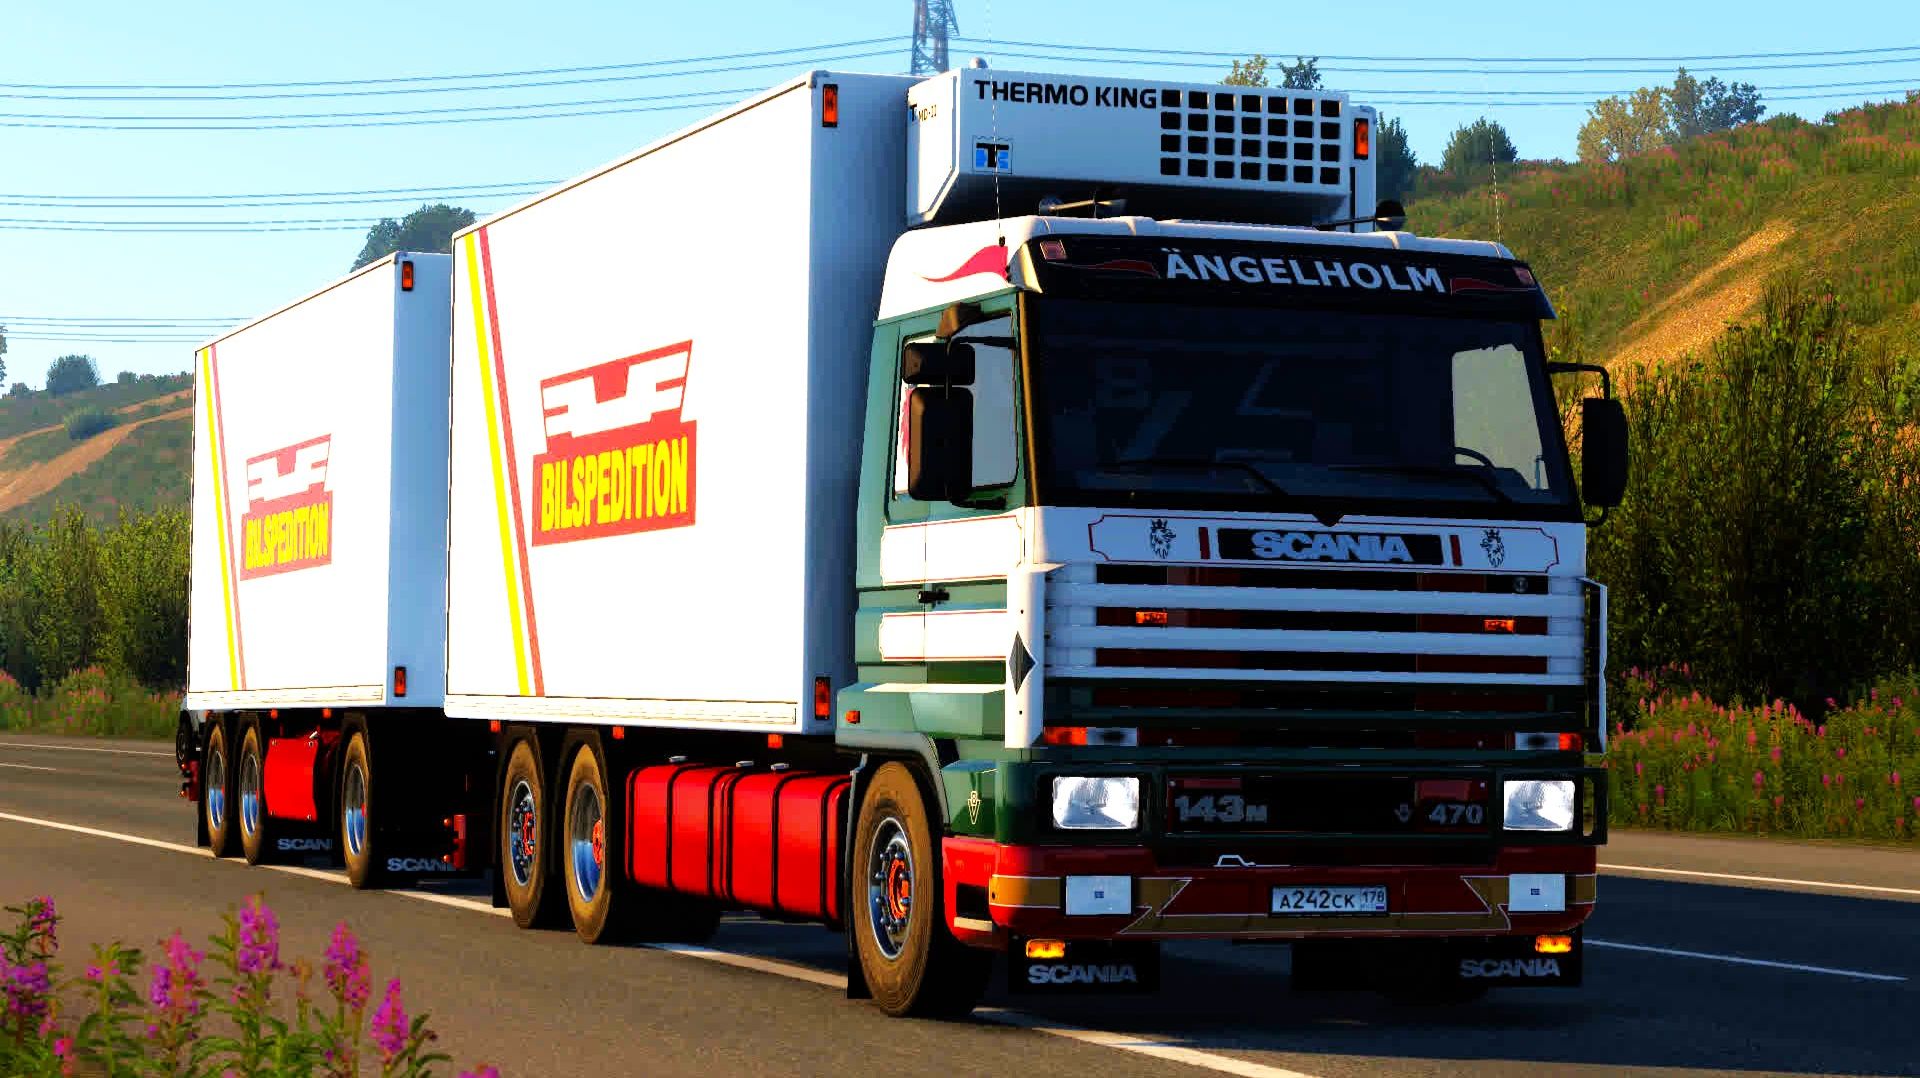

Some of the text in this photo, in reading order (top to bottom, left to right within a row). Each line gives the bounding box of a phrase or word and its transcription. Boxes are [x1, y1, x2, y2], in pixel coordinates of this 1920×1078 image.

[974, 79, 1157, 109] THERMO KING
[1161, 247, 1446, 293] ÄNGELHOLM
[540, 436, 688, 532] BILSPEDITION
[245, 502, 329, 571] BILSPEDITION
[1251, 531, 1415, 562] SCANIA
[1428, 803, 1484, 825] 470
[277, 838, 333, 851] SCAN
[1028, 964, 1138, 983] SCANIA
[1459, 958, 1562, 978] SCANIA
